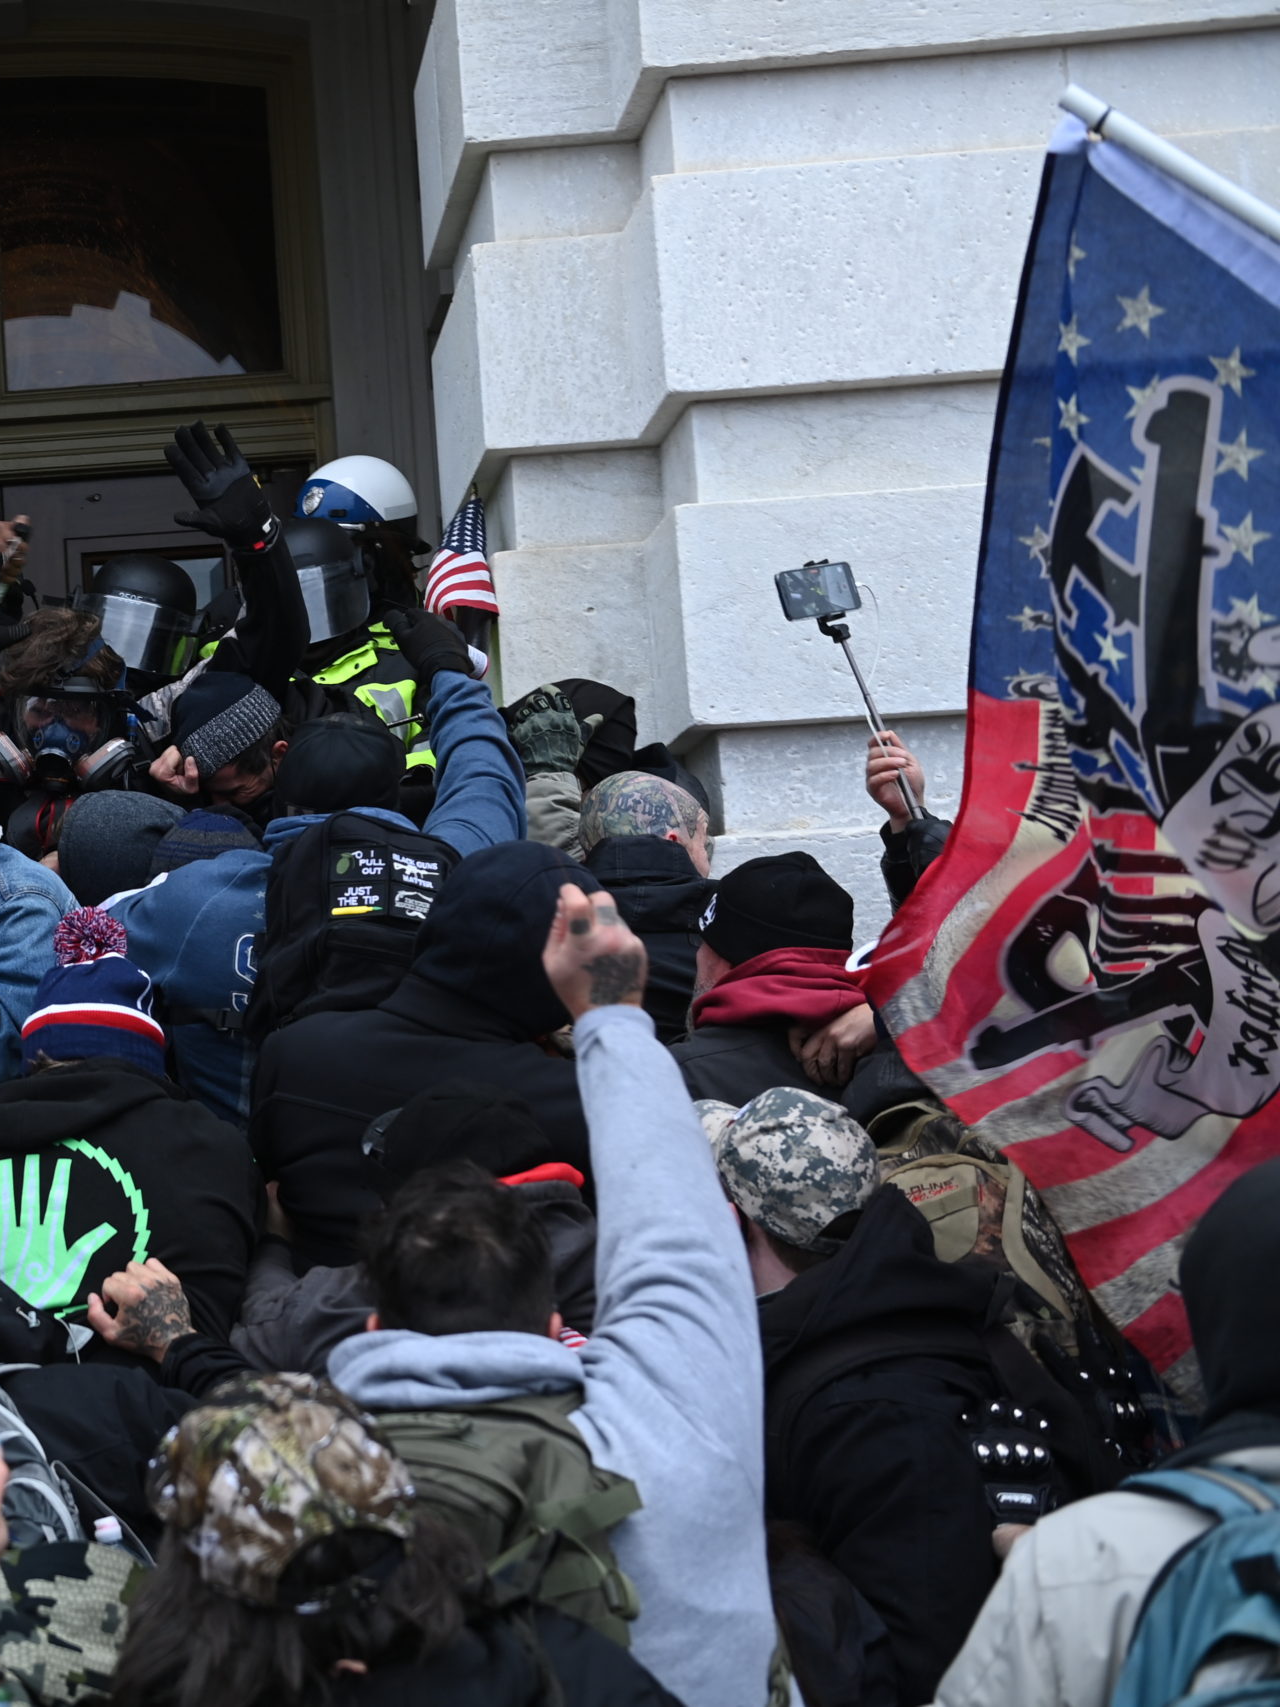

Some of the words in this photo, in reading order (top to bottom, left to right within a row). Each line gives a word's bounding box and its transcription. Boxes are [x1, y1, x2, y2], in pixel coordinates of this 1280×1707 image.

[370, 850, 375, 858] I
[359, 859, 386, 867] PULL
[392, 853, 416, 867] BLACK
[416, 861, 438, 871] GUNS
[361, 867, 384, 875] OUT
[402, 874, 434, 889] MATTER
[344, 886, 372, 897] JUST
[337, 896, 359, 907] THE
[362, 895, 380, 905] TIP
